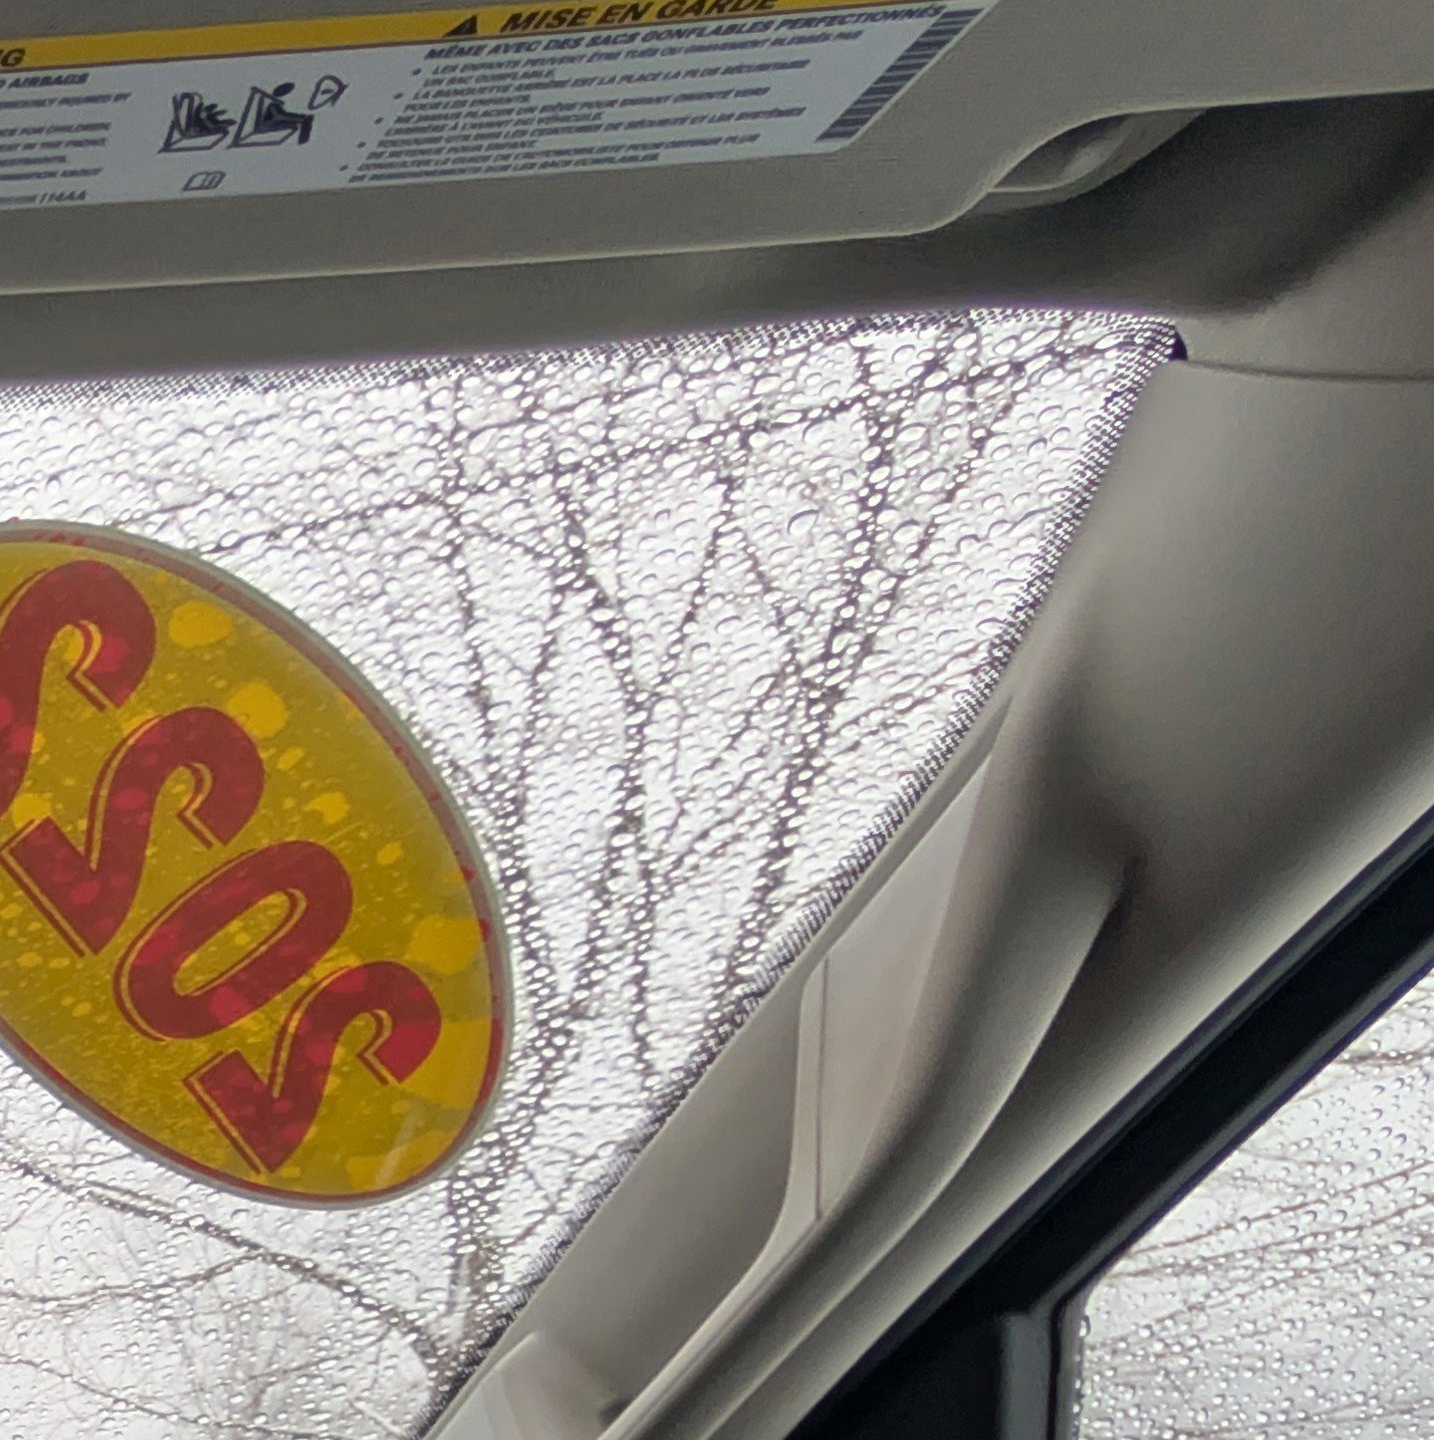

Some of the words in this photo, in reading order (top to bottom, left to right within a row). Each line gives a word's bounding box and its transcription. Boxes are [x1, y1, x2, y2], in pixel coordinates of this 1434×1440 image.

[500, 6, 597, 33] MISE
[597, 2, 654, 27] EN
[487, 39, 543, 56] AVEC
[544, 35, 584, 52] DES
[7, 72, 90, 89] AIRBAGS
